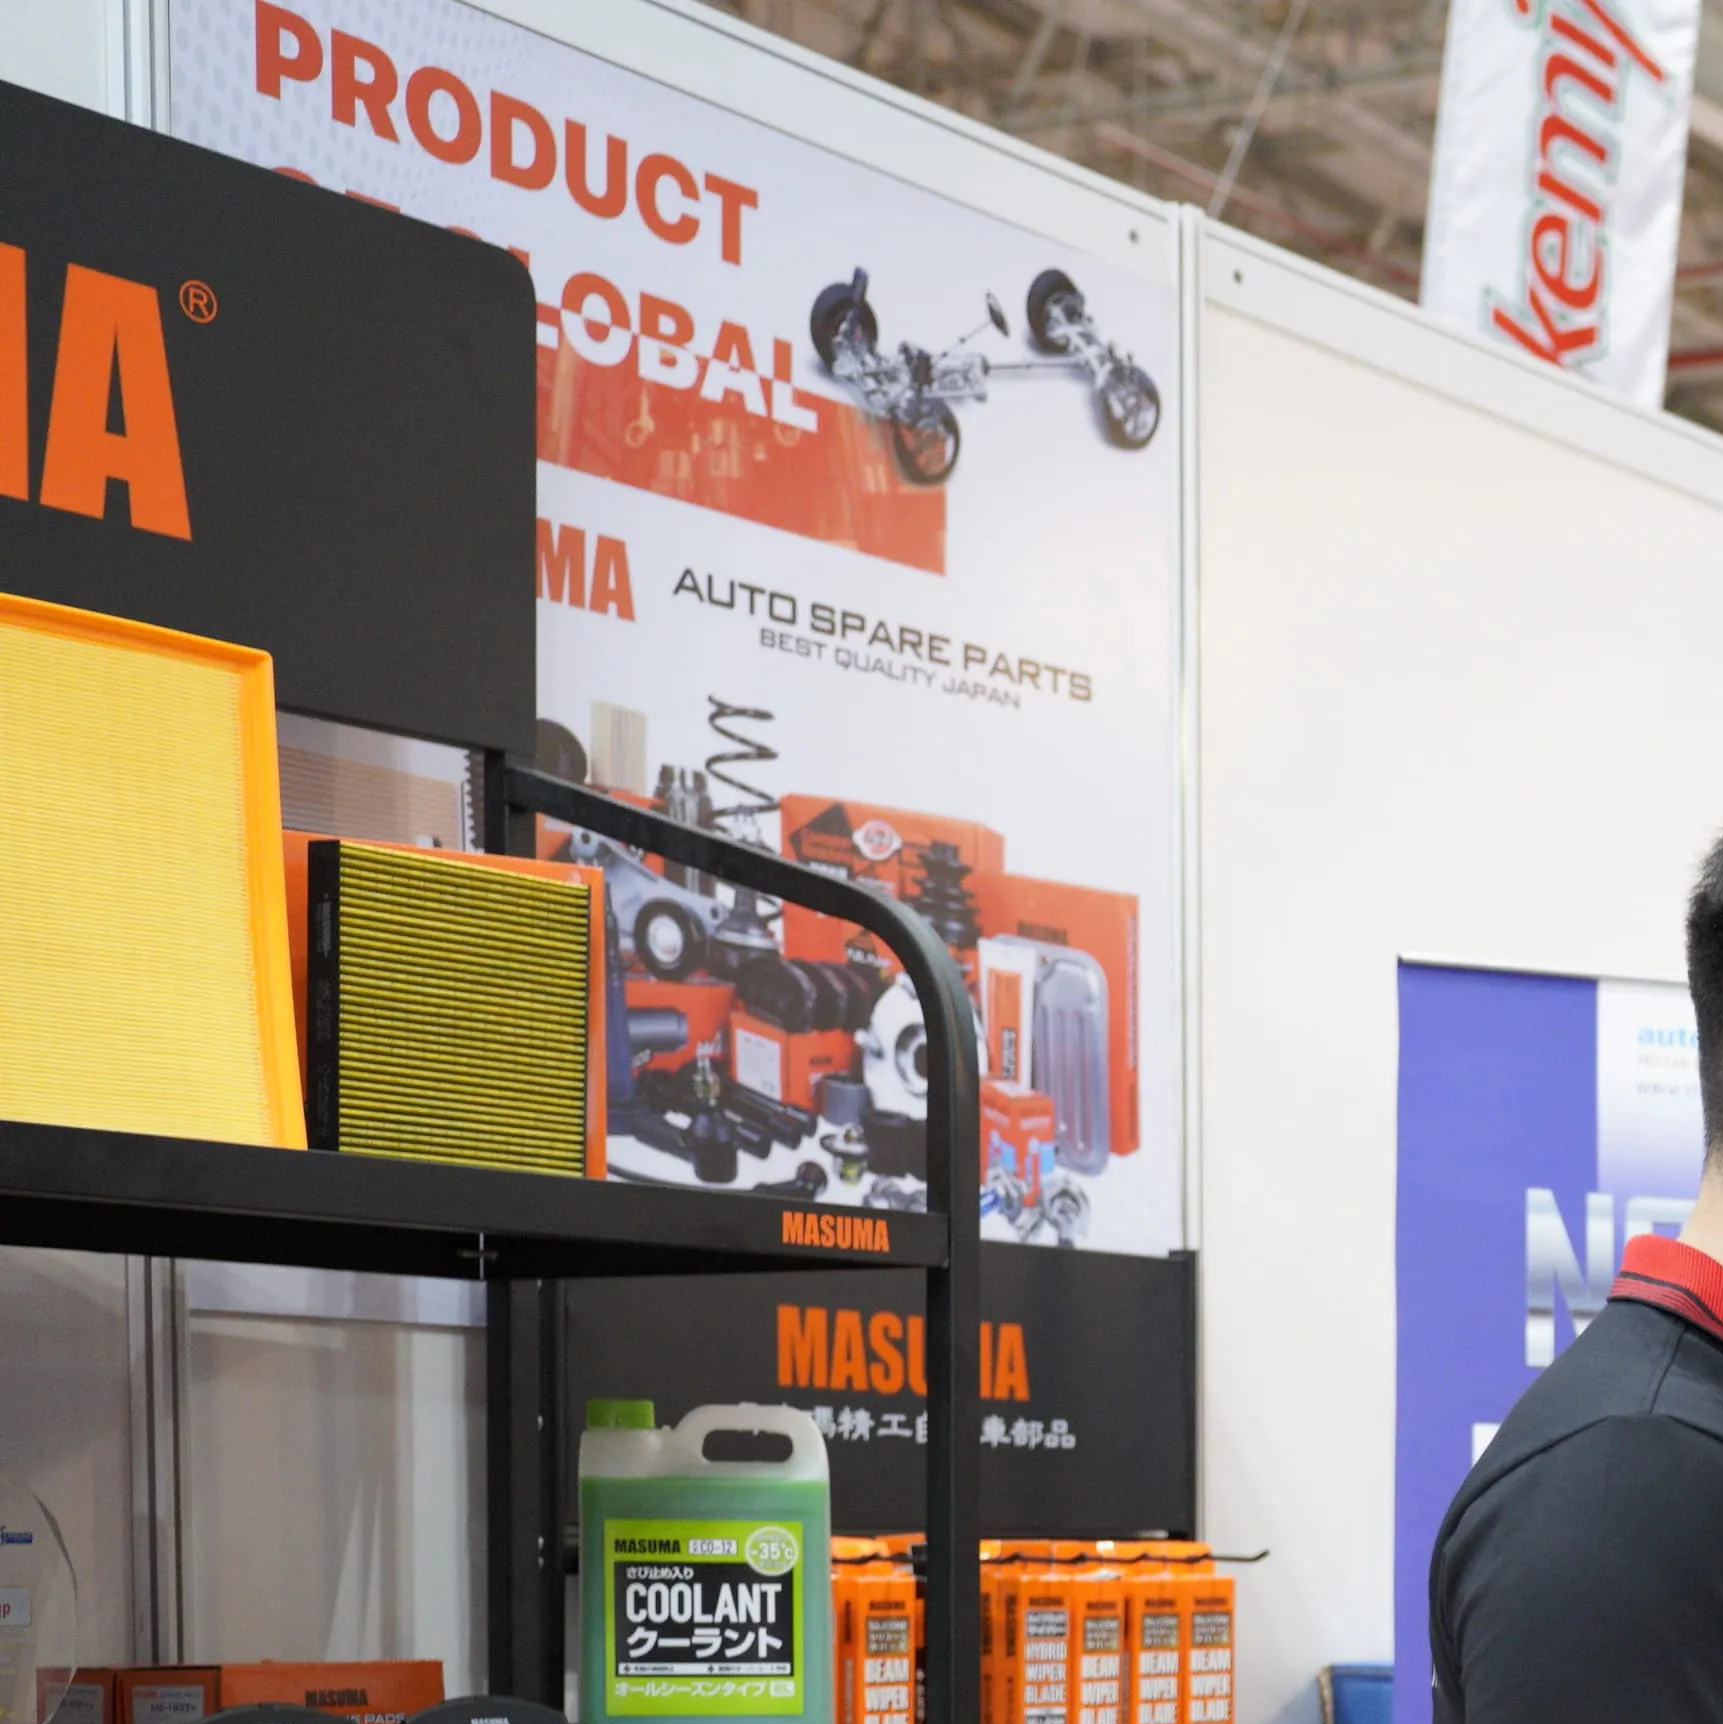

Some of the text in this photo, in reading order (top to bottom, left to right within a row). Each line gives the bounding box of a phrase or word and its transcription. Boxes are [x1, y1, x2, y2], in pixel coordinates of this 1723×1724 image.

[255, 0, 759, 266] PRODUCT
[505, 246, 818, 432] OBAL
[674, 568, 1094, 702] AUTO SPARE PARTS
[760, 627, 1022, 709] BEST QUALITY JAPAN
[781, 1210, 890, 1253] MASUMA
[776, 1303, 1031, 1403] MASUA
[614, 1538, 681, 1554] MASUMA
[626, 1582, 783, 1624] COOLANT
[626, 1626, 783, 1658] クーラント
[305, 1688, 369, 1708] MASUMA
[615, 1681, 768, 1697] オールシーズンタイプ
